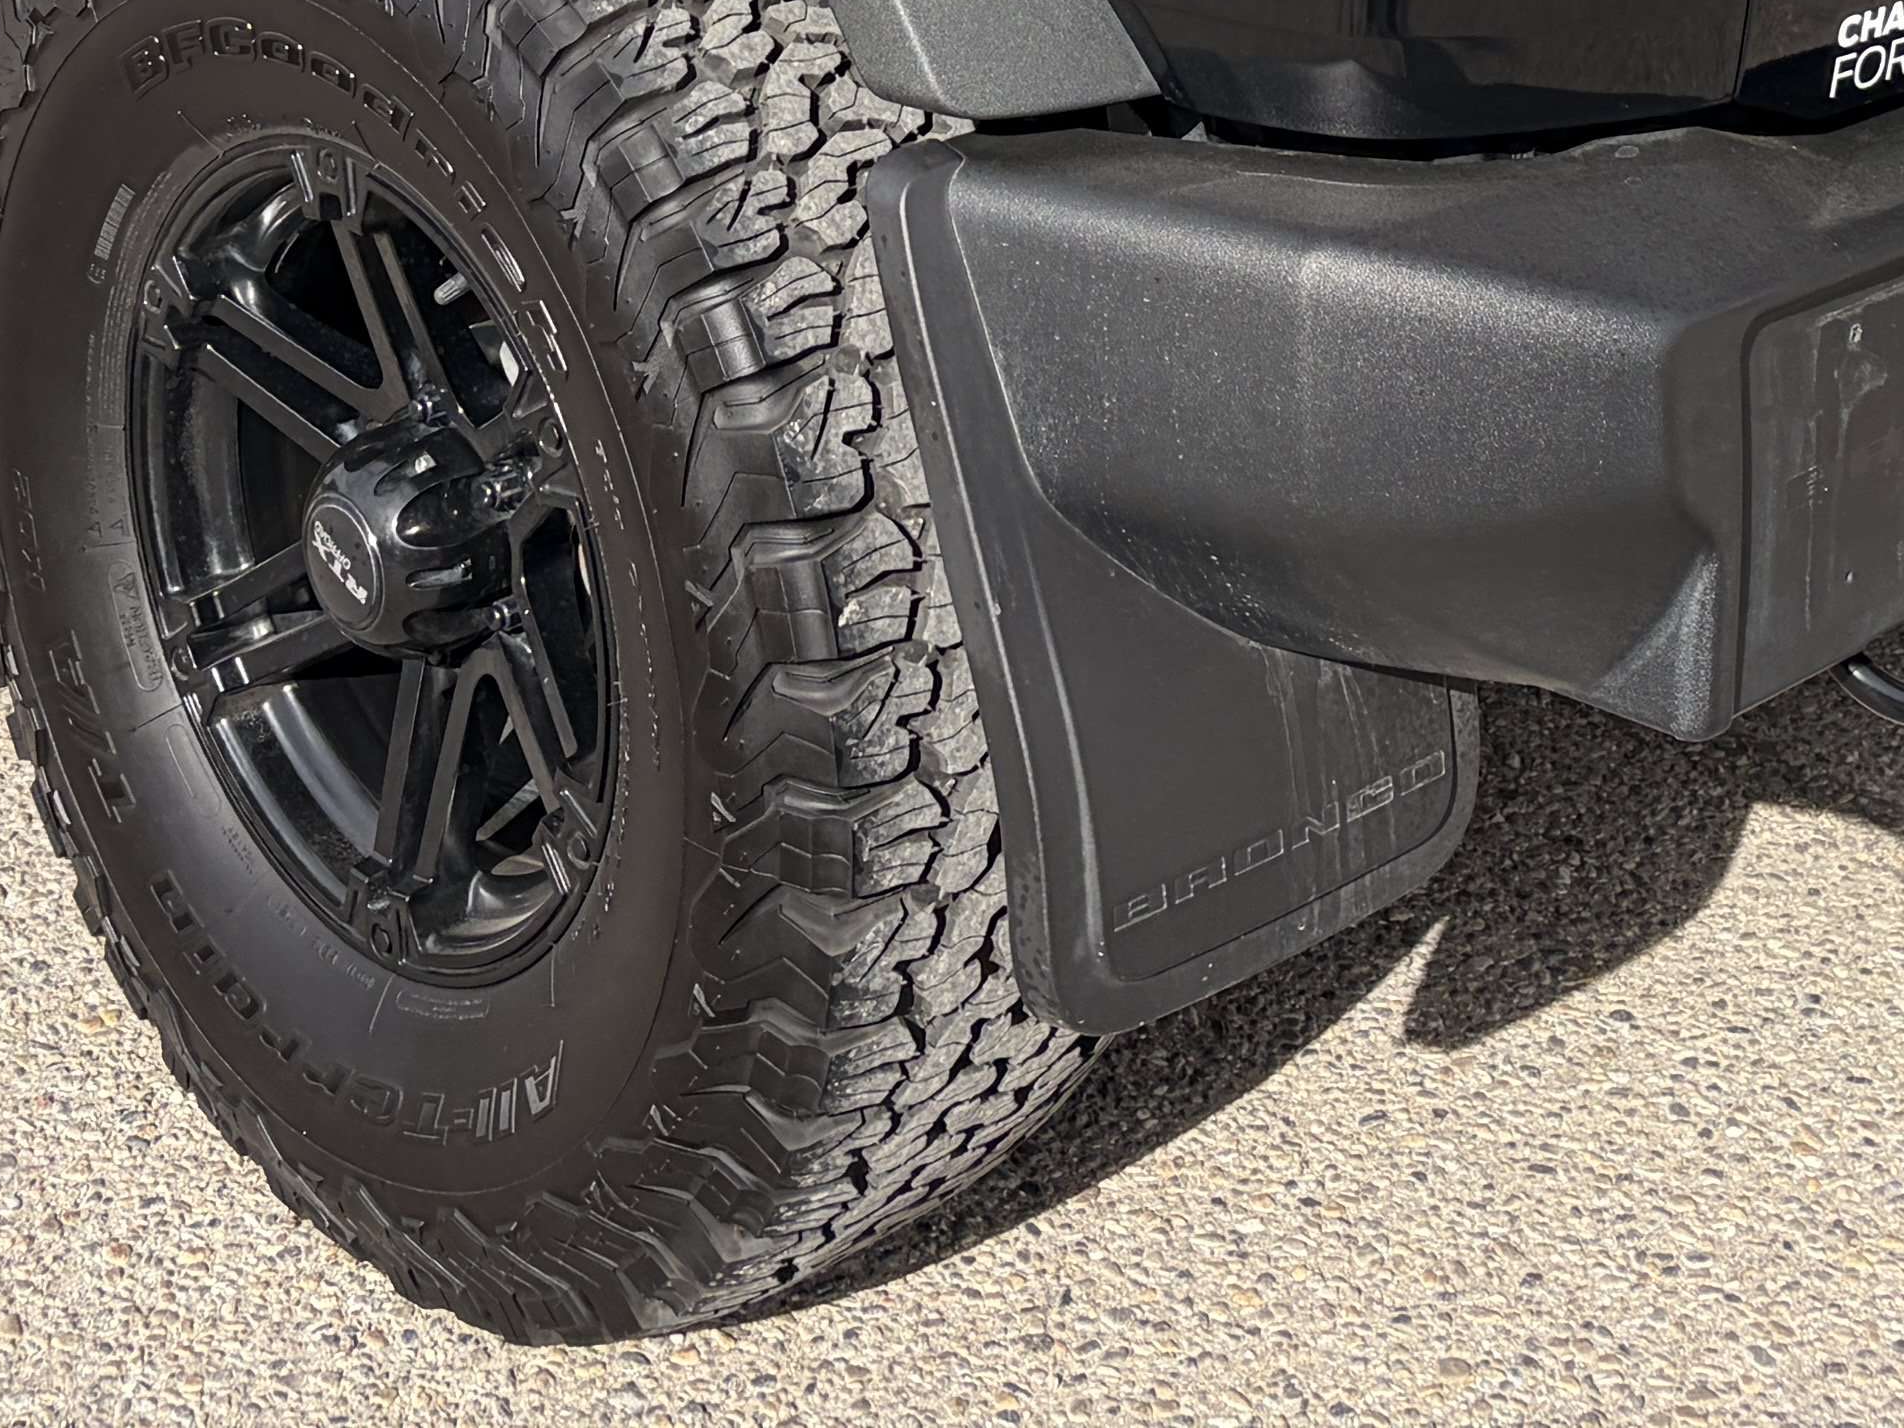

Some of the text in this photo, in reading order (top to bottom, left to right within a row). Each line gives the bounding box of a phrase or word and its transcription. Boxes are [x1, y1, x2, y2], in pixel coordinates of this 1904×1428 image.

[116, 14, 570, 378] BFGoodrich
[312, 530, 369, 606] RTX
[1110, 748, 1448, 934] BRONCO
[146, 864, 566, 1149] All-Terrain
